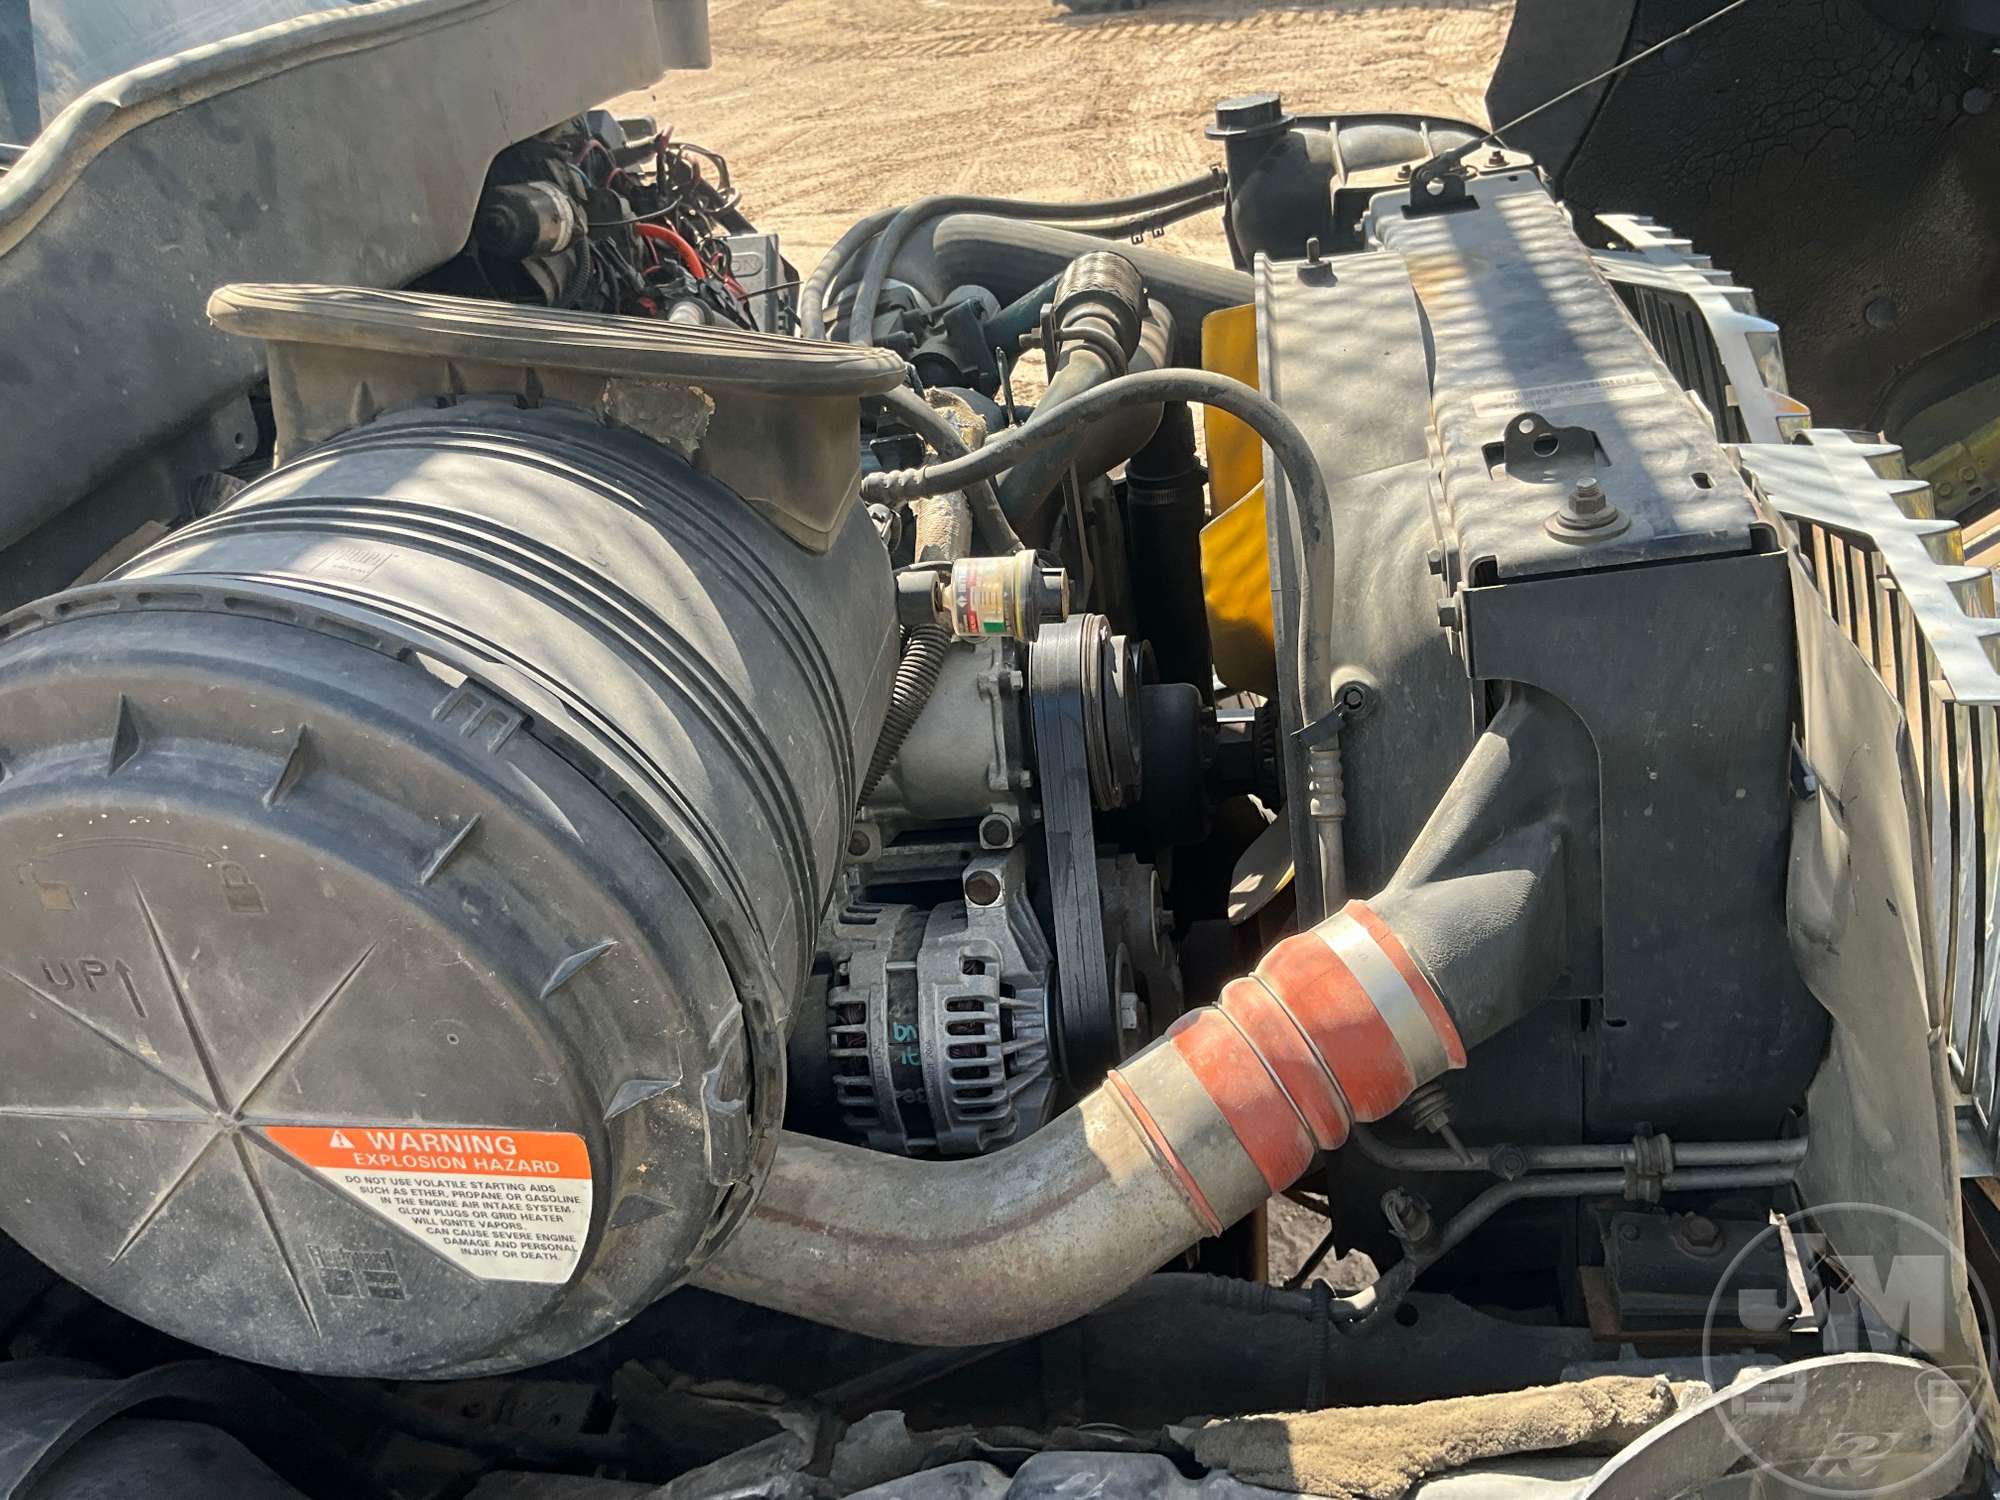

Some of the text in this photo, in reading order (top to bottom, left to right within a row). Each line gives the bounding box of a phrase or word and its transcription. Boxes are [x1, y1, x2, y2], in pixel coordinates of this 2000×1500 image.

[41, 958, 107, 993] UP
[366, 1131, 517, 1155] WARNING
[353, 1152, 560, 1174] EXPLOSION HAZARD
[345, 1175, 556, 1192] DO NOT USE VOLATILE STARTING AIDS
[360, 1186, 390, 1194] SUCH
[393, 1187, 408, 1195] AS
[452, 1190, 503, 1199] PROPANE
[506, 1193, 522, 1201] OR
[525, 1194, 581, 1204] GASOLINE
[380, 1196, 575, 1213] IN THE ENGINE AIR INTAKE SYSTEM.
[398, 1207, 564, 1222] GLOW PLUGS OR GRID HEATER
[411, 1217, 527, 1231] WILL IGNITE VAPORS.
[426, 1227, 576, 1243] CAN CAUSE SEVERE ENGINE
[443, 1237, 578, 1252] DAMAGE AND PERSONAL
[461, 1247, 561, 1260] INJURY OR DEATH.
